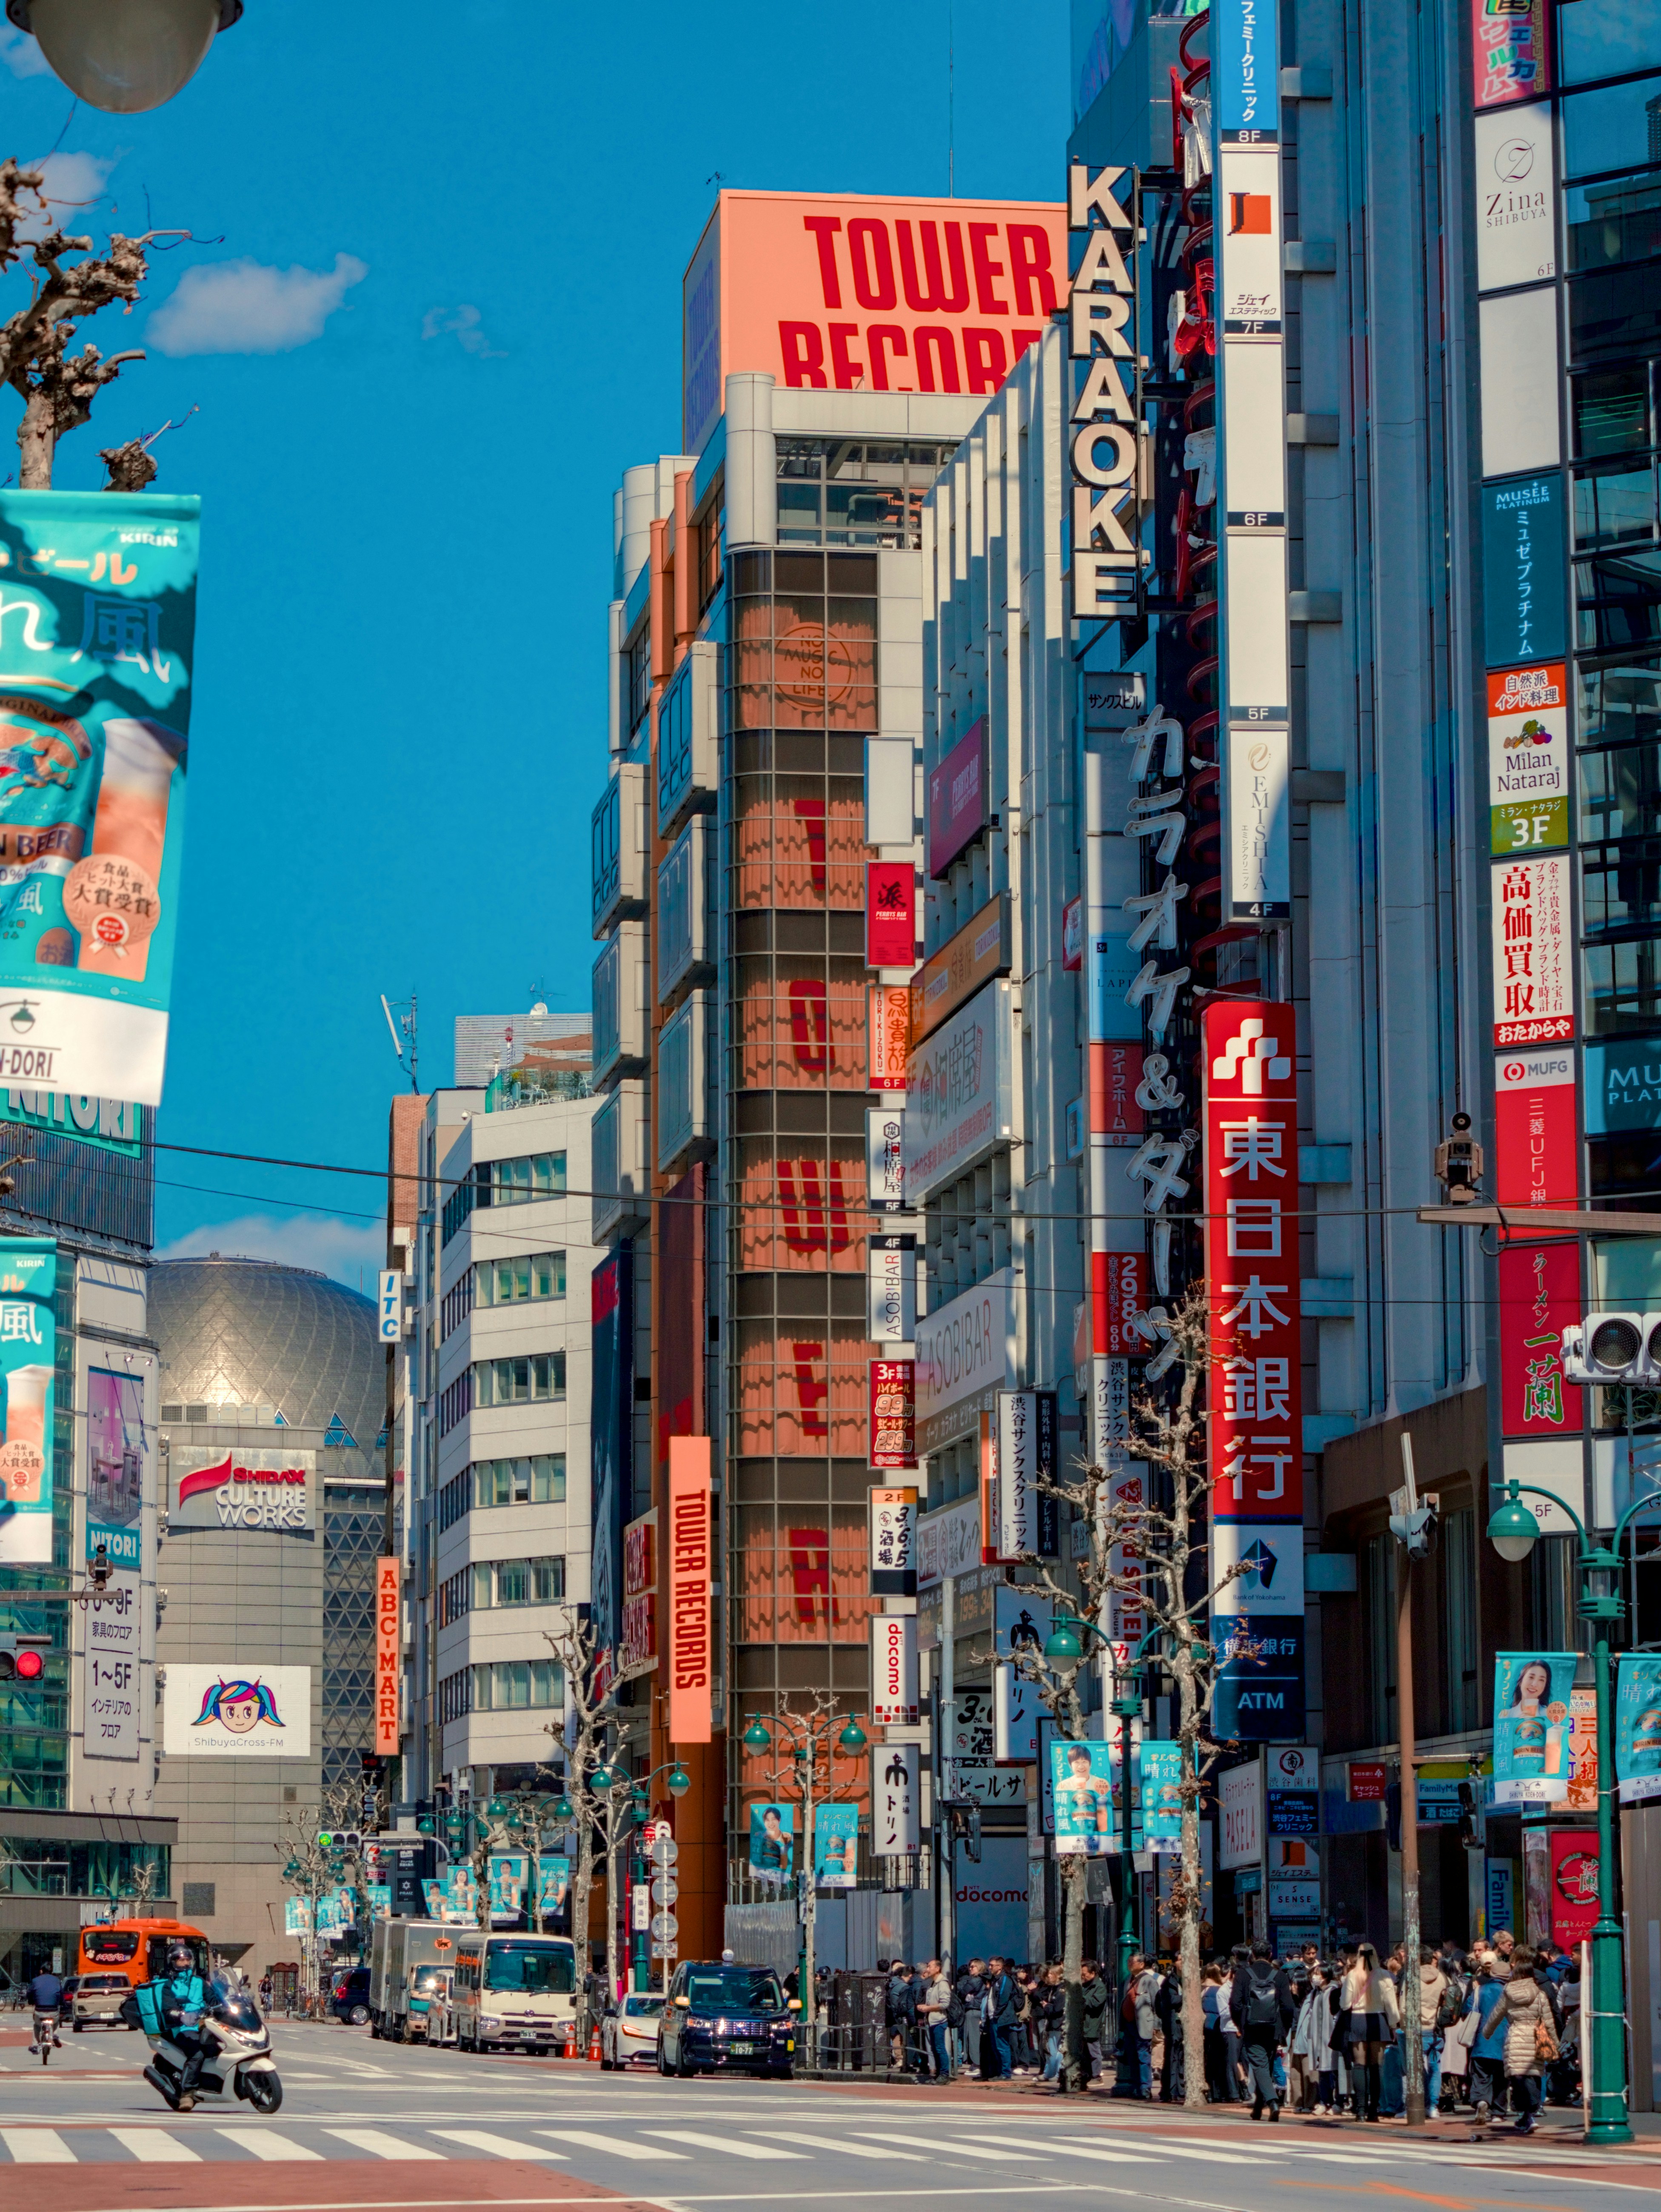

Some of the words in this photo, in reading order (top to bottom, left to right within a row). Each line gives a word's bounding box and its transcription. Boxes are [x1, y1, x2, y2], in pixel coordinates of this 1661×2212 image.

[1239, 131, 1261, 143] 8F
[1486, 191, 1546, 216] Zina
[1486, 209, 1547, 228] SHIBUYA
[804, 215, 1058, 317] TOWER
[1537, 263, 1554, 277] 6F
[1237, 294, 1270, 306] ジェイ
[1229, 307, 1277, 316] エステティック
[1241, 322, 1264, 334] 7F
[778, 320, 1042, 394] RECOR
[1070, 164, 1138, 616] KARAOKE
[1496, 496, 1550, 510] PLATINUM
[1244, 513, 1268, 526] 6F
[120, 532, 177, 547] KIRIN
[1516, 511, 1533, 656] ミュゼプラチナム
[801, 634, 823, 647] NO
[801, 666, 824, 680] NO
[1506, 670, 1548, 692] 自然派
[1088, 694, 1142, 710] サンクスビル
[1495, 687, 1559, 711] インド料理
[1248, 708, 1269, 720] 5F
[970, 754, 978, 784] BAR
[1506, 752, 1552, 772] Milan
[1497, 766, 1560, 792] Nataraj
[1500, 800, 1561, 818] ミラン・ナタラジ
[1251, 776, 1270, 891] EMISHIA
[1512, 815, 1550, 847] 3F
[17, 828, 71, 857] BEER
[103, 861, 129, 878] 食品
[87, 872, 144, 896] ヒット大賞
[73, 885, 157, 919] 大賞受賞
[1250, 903, 1273, 916] 4F
[1501, 866, 1535, 1018] 高価買取
[1535, 862, 1550, 1012] ブランドバッグ・ブランド時計
[1097, 979, 1131, 988] LAPI
[1498, 1019, 1571, 1044] おたからや
[1528, 1060, 1567, 1077] MUFG
[884, 1078, 900, 1087] 6F
[1113, 1048, 1127, 1129] アイワホーム
[1113, 1135, 1127, 1145] 6F
[1529, 1098, 1547, 1210] 三菱UFJ銀
[883, 1140, 902, 1193] 相席屋
[886, 1202, 900, 1211] 5F
[885, 1238, 900, 1249] 4F
[16, 1260, 45, 1268] KIRIN
[885, 1255, 900, 1336] ASOBIBAR
[1532, 1253, 1550, 1328] ラーメン
[382, 1275, 398, 1337] ITC
[1219, 1116, 1293, 1500] 東日本銀行
[928, 1299, 992, 1400] ASOBIBAR
[877, 1363, 895, 1380] 3F
[1524, 1332, 1564, 1424] 一蘭
[877, 1383, 910, 1394] ハイボール
[876, 1395, 913, 1415] 99円
[1097, 1379, 1110, 1449] クリニック
[1111, 1361, 1125, 1449] 渋谷サンクス
[875, 1431, 912, 1451] 299円
[1, 1457, 40, 1468] 大賞受賞
[233, 1467, 305, 1485] SHIDAX
[1010, 1396, 1027, 1553] 渋谷サンクスクリニック
[216, 1486, 306, 1508] CULTURE
[885, 1493, 904, 1501] 2F
[217, 1505, 307, 1528] WORKS
[1535, 1504, 1553, 1517] 5F
[676, 1489, 705, 1573] TOWER
[878, 1530, 894, 1566] 酒場
[92, 1620, 132, 1641] 家具のフロア
[676, 1579, 706, 1689] RECORDS
[380, 1570, 397, 1740] ABC-MART
[888, 1623, 903, 1695] docomo
[91, 1698, 131, 1716] インテリアの
[1238, 1692, 1284, 1709] ATM
[101, 1723, 121, 1739] フロア
[194, 1737, 283, 1749] ShibuyaCross-FM
[1497, 1723, 1510, 1772] 晴れ風
[1580, 1717, 1598, 1780] 三人打
[1269, 1777, 1316, 1787] 渋谷歯科
[1419, 1783, 1459, 1794] FamilyMa
[902, 1795, 910, 1815] 酒場
[1056, 1792, 1070, 1831] 晴れ風
[1426, 1807, 1436, 1818] 酒
[1439, 1808, 1460, 1817] たばこ
[818, 1820, 855, 1832] 晴れ風
[886, 1795, 897, 1844] トリノ
[1273, 1814, 1317, 1822] 渋谷フェミー
[1226, 1806, 1255, 1855] PASELA
[1490, 1869, 1510, 1931] Family
[96, 1953, 124, 1961] ハチ公バス
